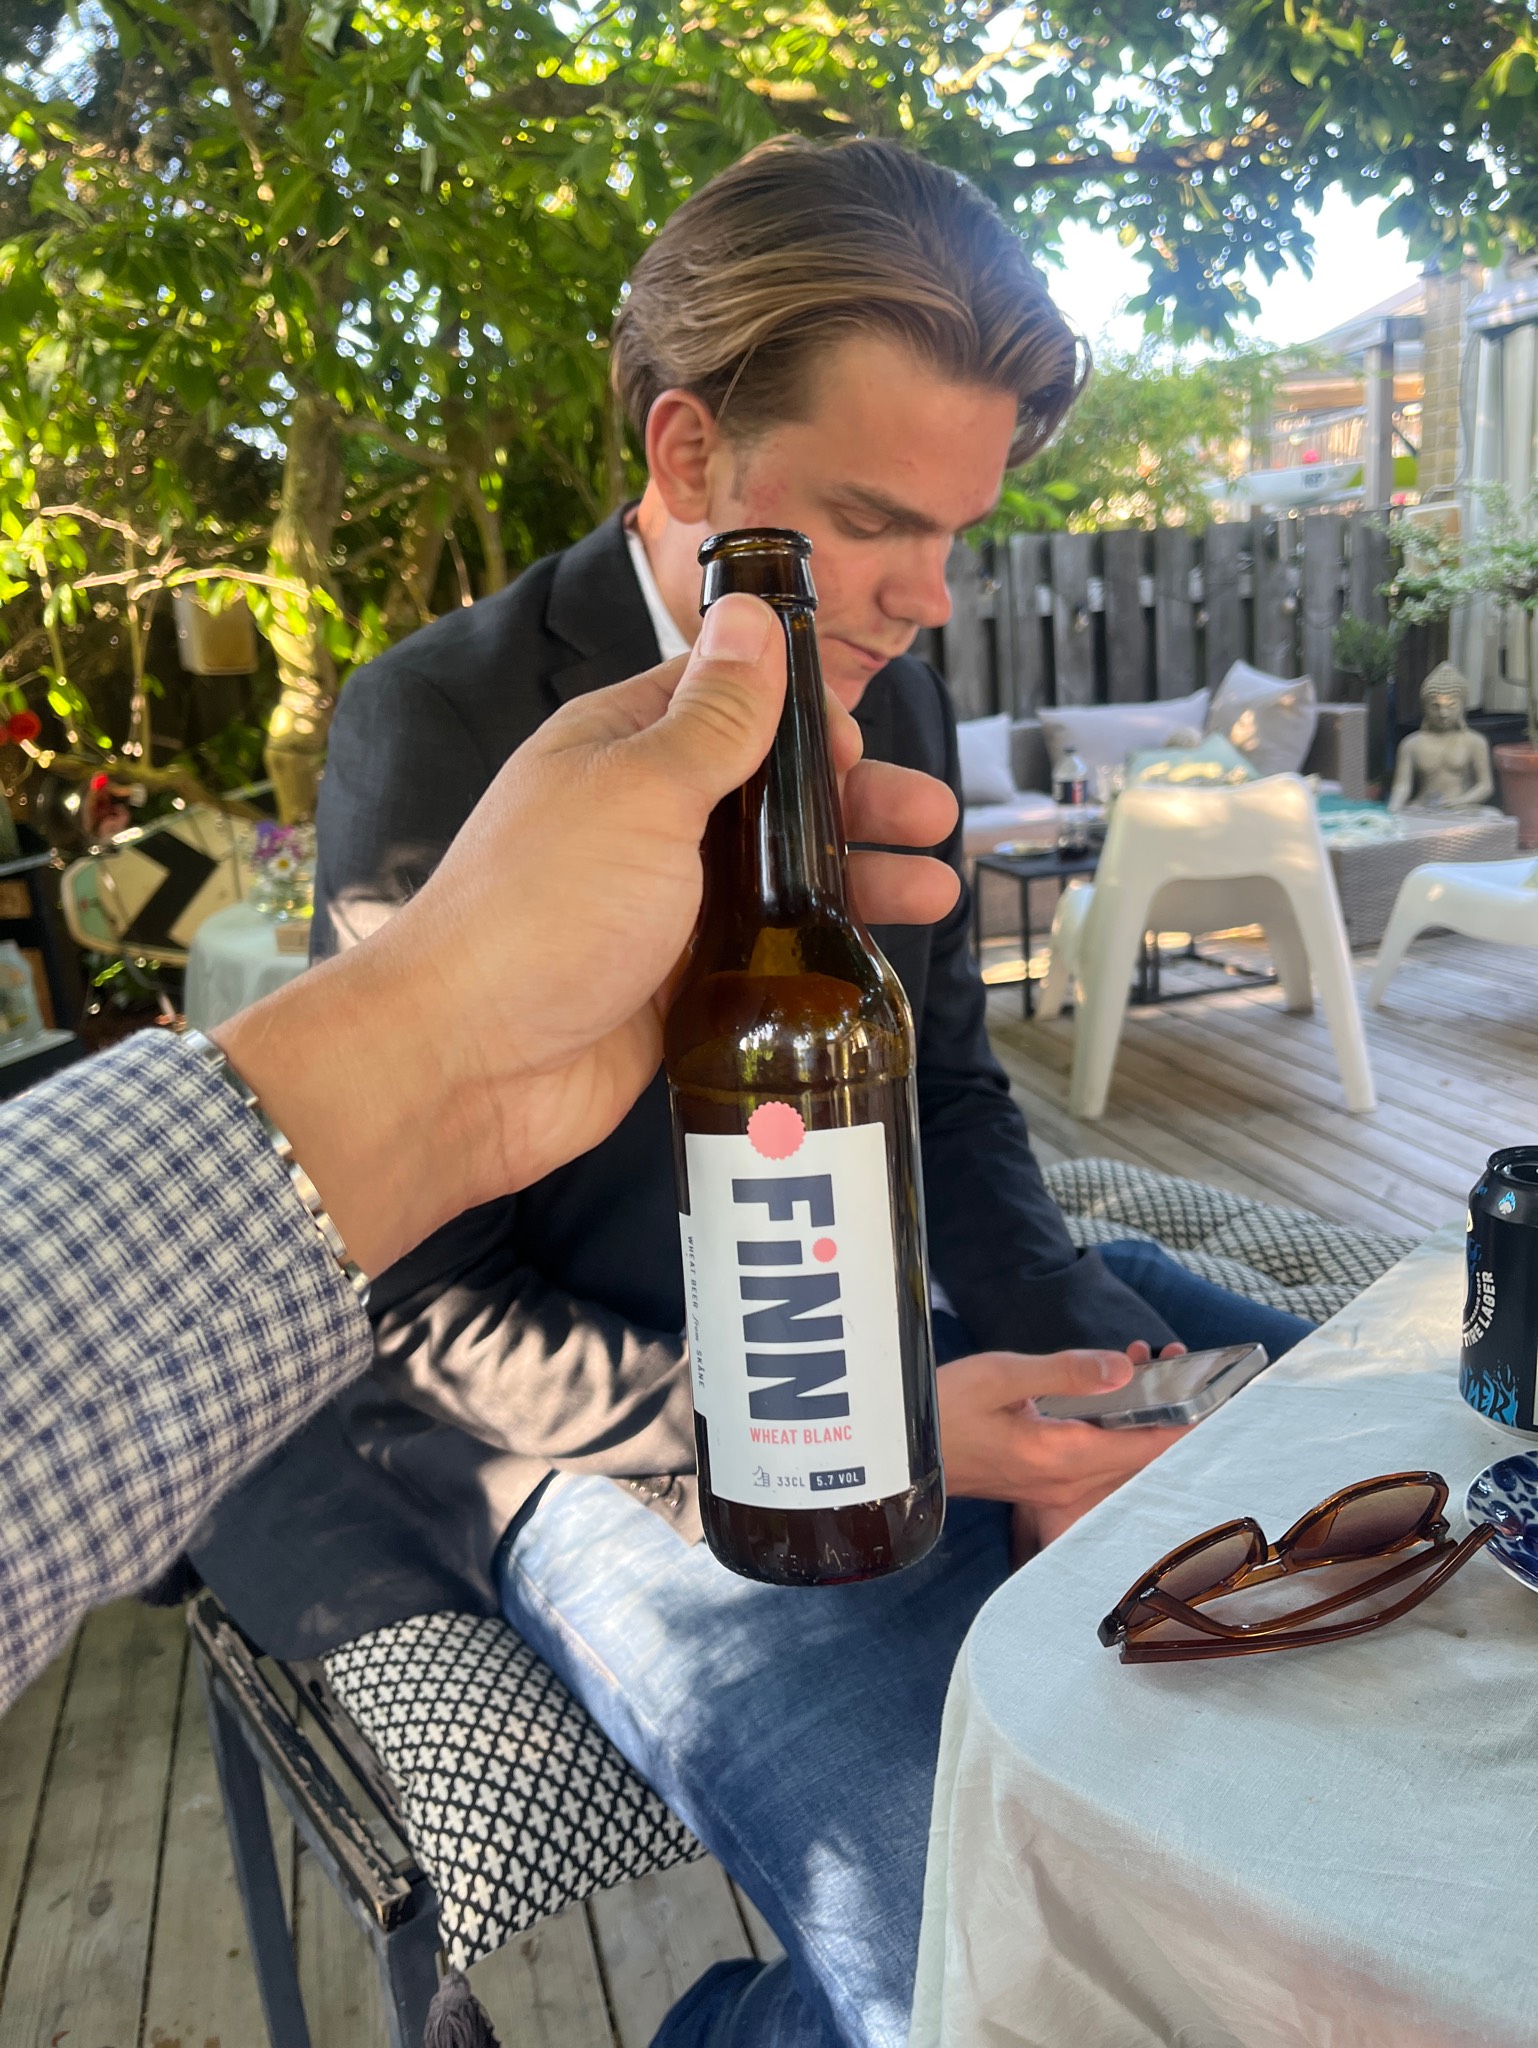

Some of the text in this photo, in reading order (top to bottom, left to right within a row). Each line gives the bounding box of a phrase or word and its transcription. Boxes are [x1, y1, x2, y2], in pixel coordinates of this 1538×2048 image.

[688, 1235, 696, 1276] WHEAT
[690, 1279, 698, 1309] BEER
[1477, 1271, 1497, 1330] LAGER
[749, 1424, 853, 1445] WHEAT BLANC
[776, 1471, 860, 1488] 33CL 5.7 VOL
